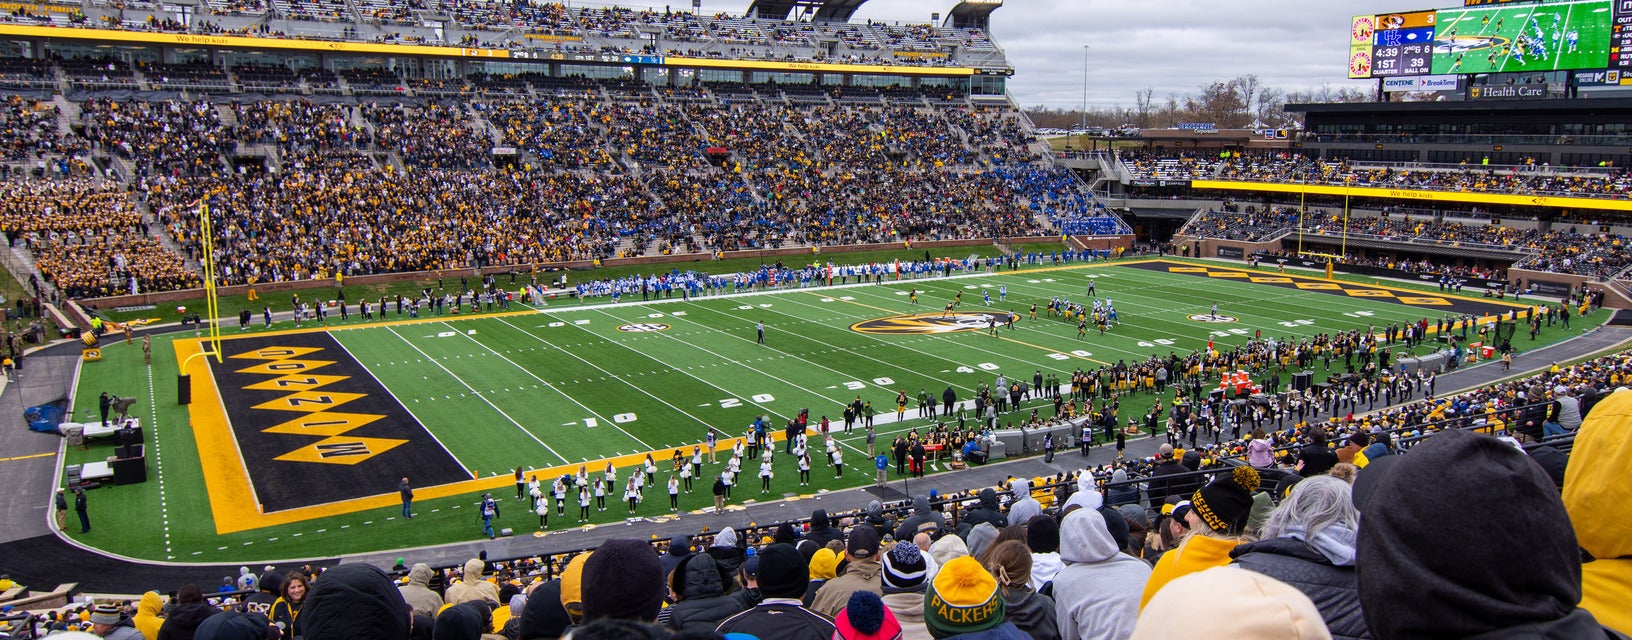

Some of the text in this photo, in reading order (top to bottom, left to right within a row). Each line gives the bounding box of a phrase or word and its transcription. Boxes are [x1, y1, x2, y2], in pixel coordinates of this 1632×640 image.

[1426, 14, 1434, 24] 3
[192, 36, 210, 45] help
[1426, 31, 1433, 40] 7
[1376, 48, 1398, 57] 4:39
[1424, 45, 1430, 53] 6
[1377, 59, 1396, 69] 1ST
[1410, 58, 1424, 67] 39
[1385, 79, 1413, 87] CENTENE
[1426, 79, 1456, 87] BreakTime
[1483, 86, 1542, 97] Health Care
[1402, 191, 1418, 199] help
[1047, 350, 1093, 361] 50
[956, 362, 1000, 374] 40
[842, 376, 895, 391] 30
[719, 393, 775, 409] 20
[582, 412, 638, 428] 10
[931, 594, 998, 623] PACKERS
